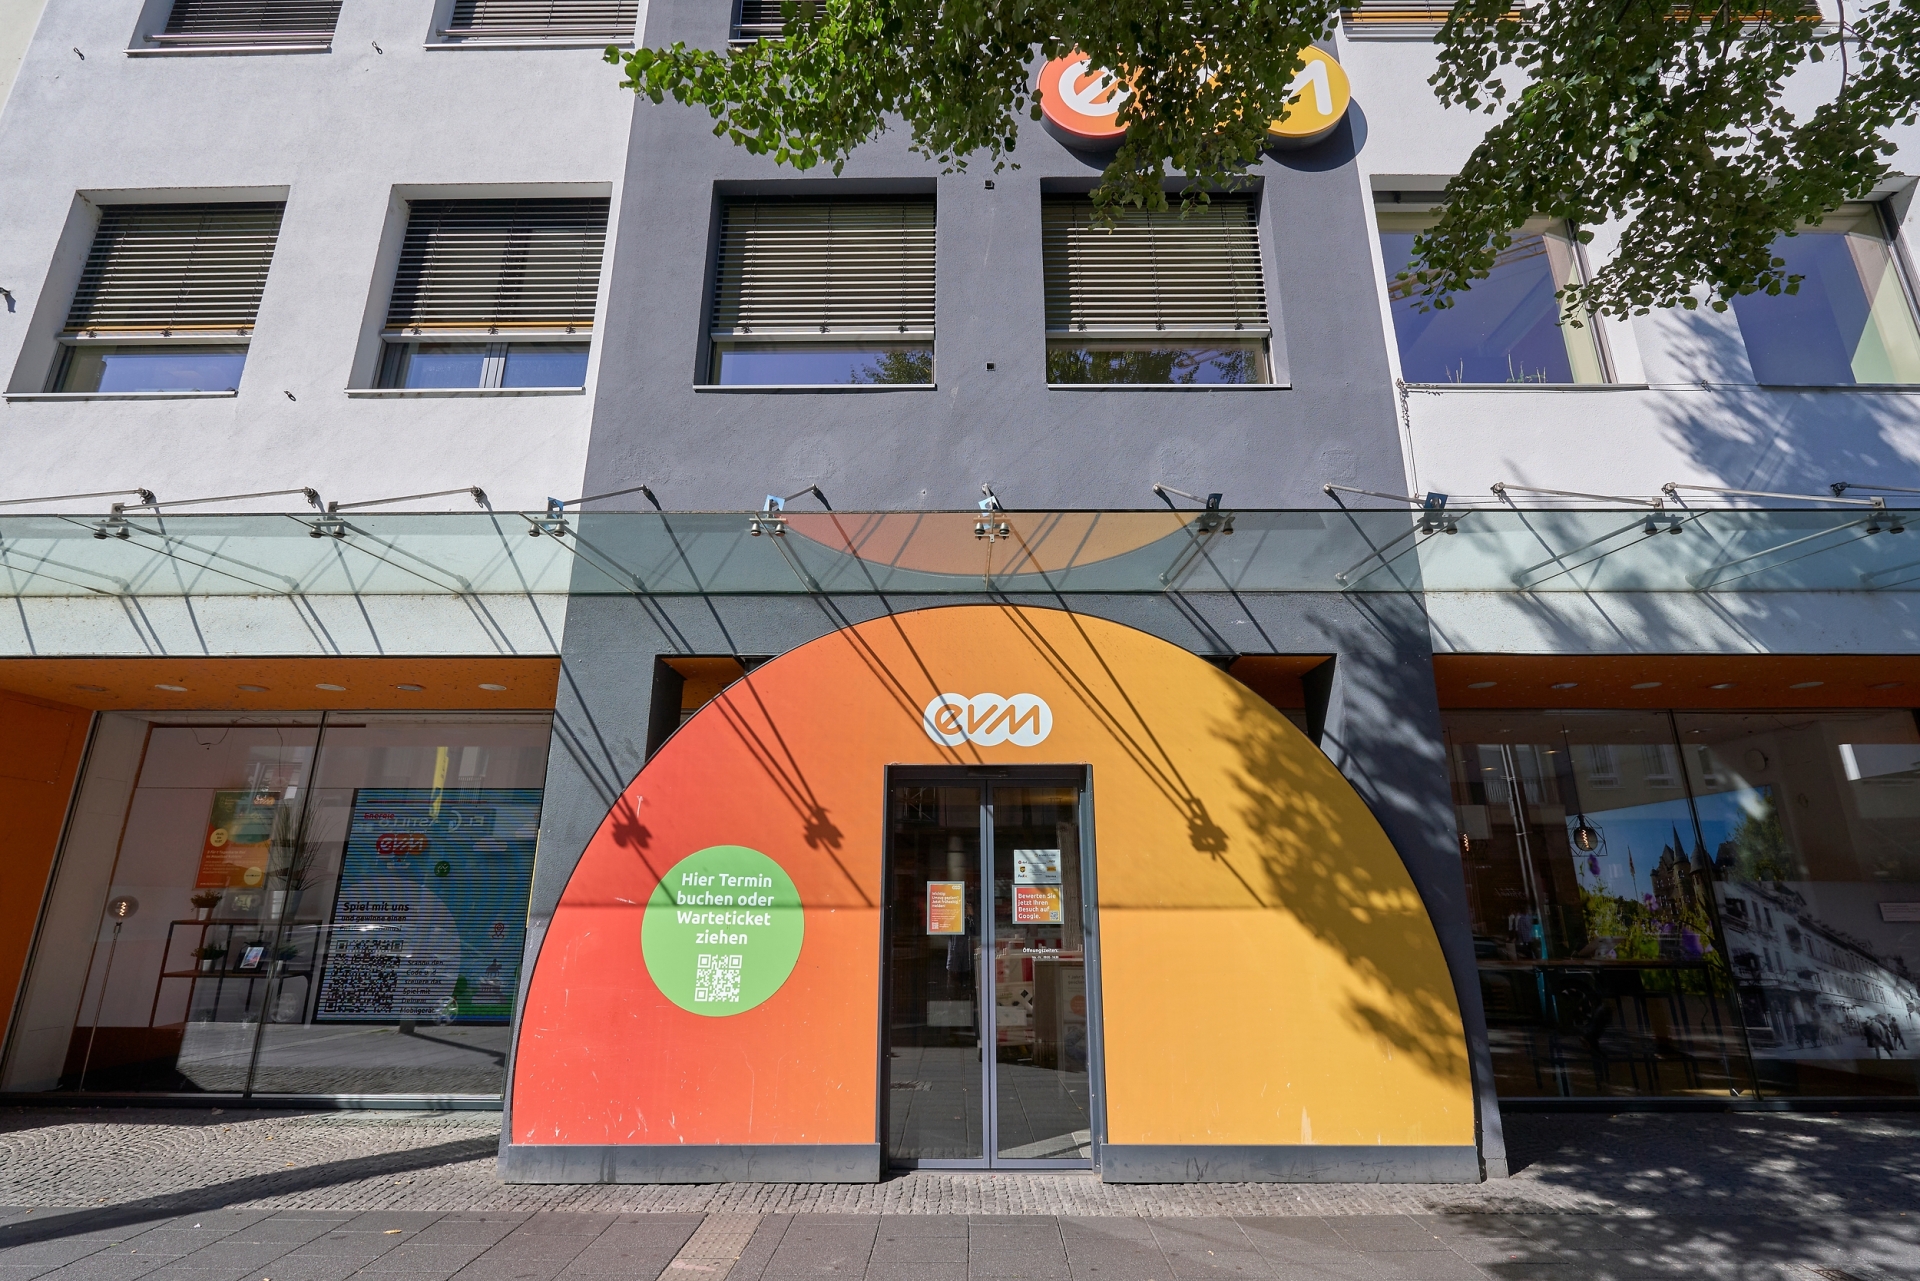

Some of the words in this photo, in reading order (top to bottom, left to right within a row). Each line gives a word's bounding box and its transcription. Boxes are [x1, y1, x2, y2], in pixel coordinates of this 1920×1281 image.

[934, 703, 1040, 736] evm
[681, 871, 715, 887] Hier
[719, 873, 773, 888] Termin
[676, 890, 734, 906] buchen
[737, 891, 775, 907] oder
[342, 901, 370, 913] Spiel
[371, 901, 389, 911] mit
[391, 903, 410, 911] uns
[676, 910, 771, 926] Warteticket
[695, 929, 748, 945] ziehen
